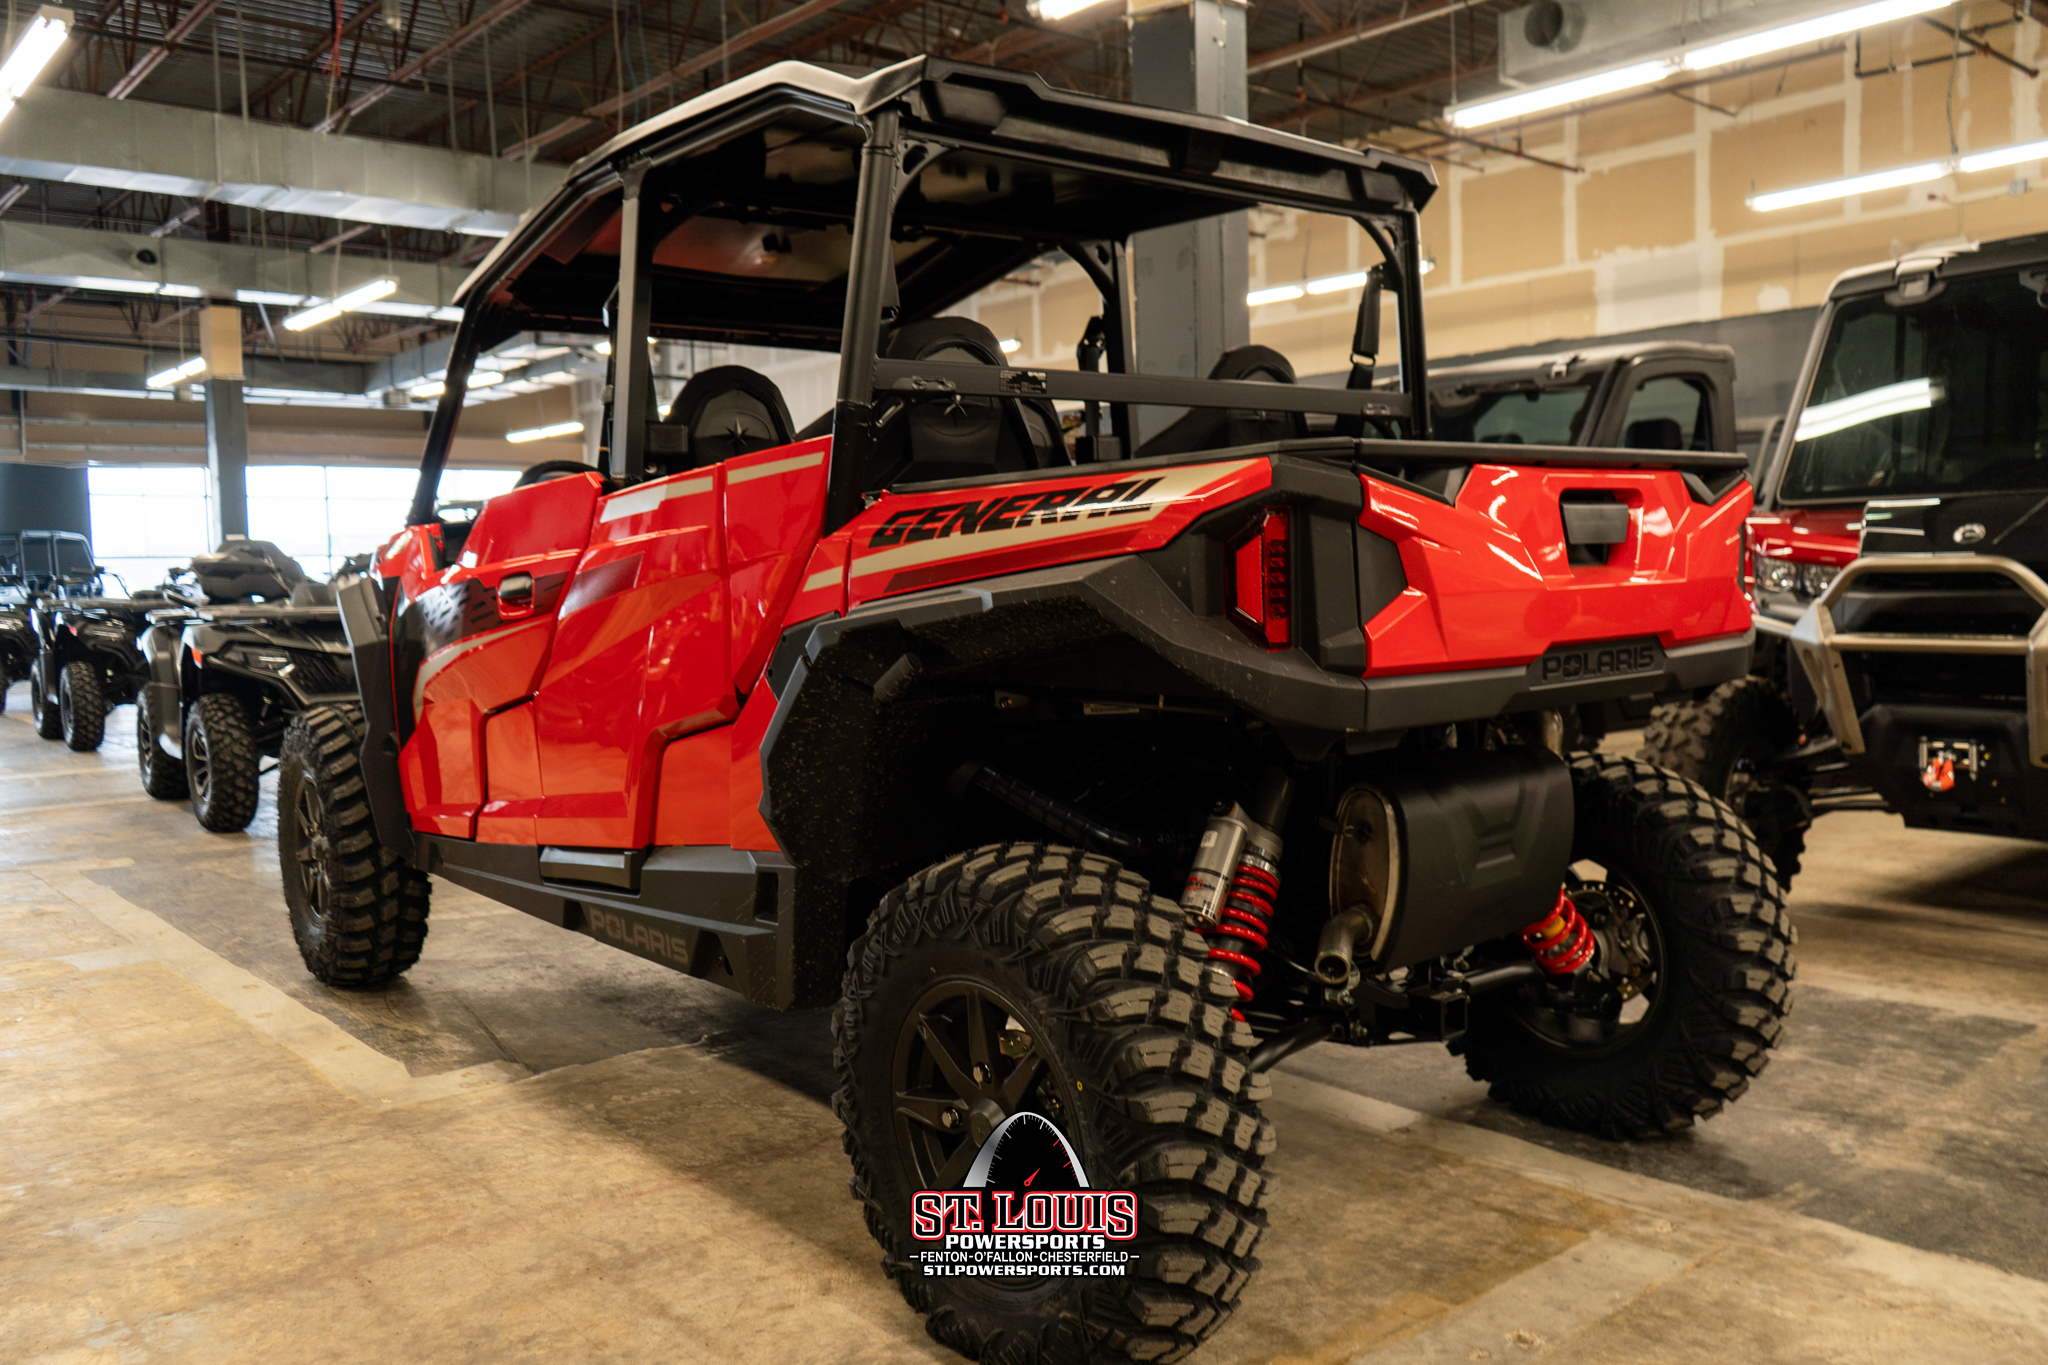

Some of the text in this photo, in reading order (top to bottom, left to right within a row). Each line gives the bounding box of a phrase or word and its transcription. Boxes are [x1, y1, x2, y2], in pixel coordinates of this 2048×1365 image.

[868, 476, 1166, 549] GENERAL
[1542, 646, 1655, 681] POLARIS
[589, 907, 689, 964] POLARIS
